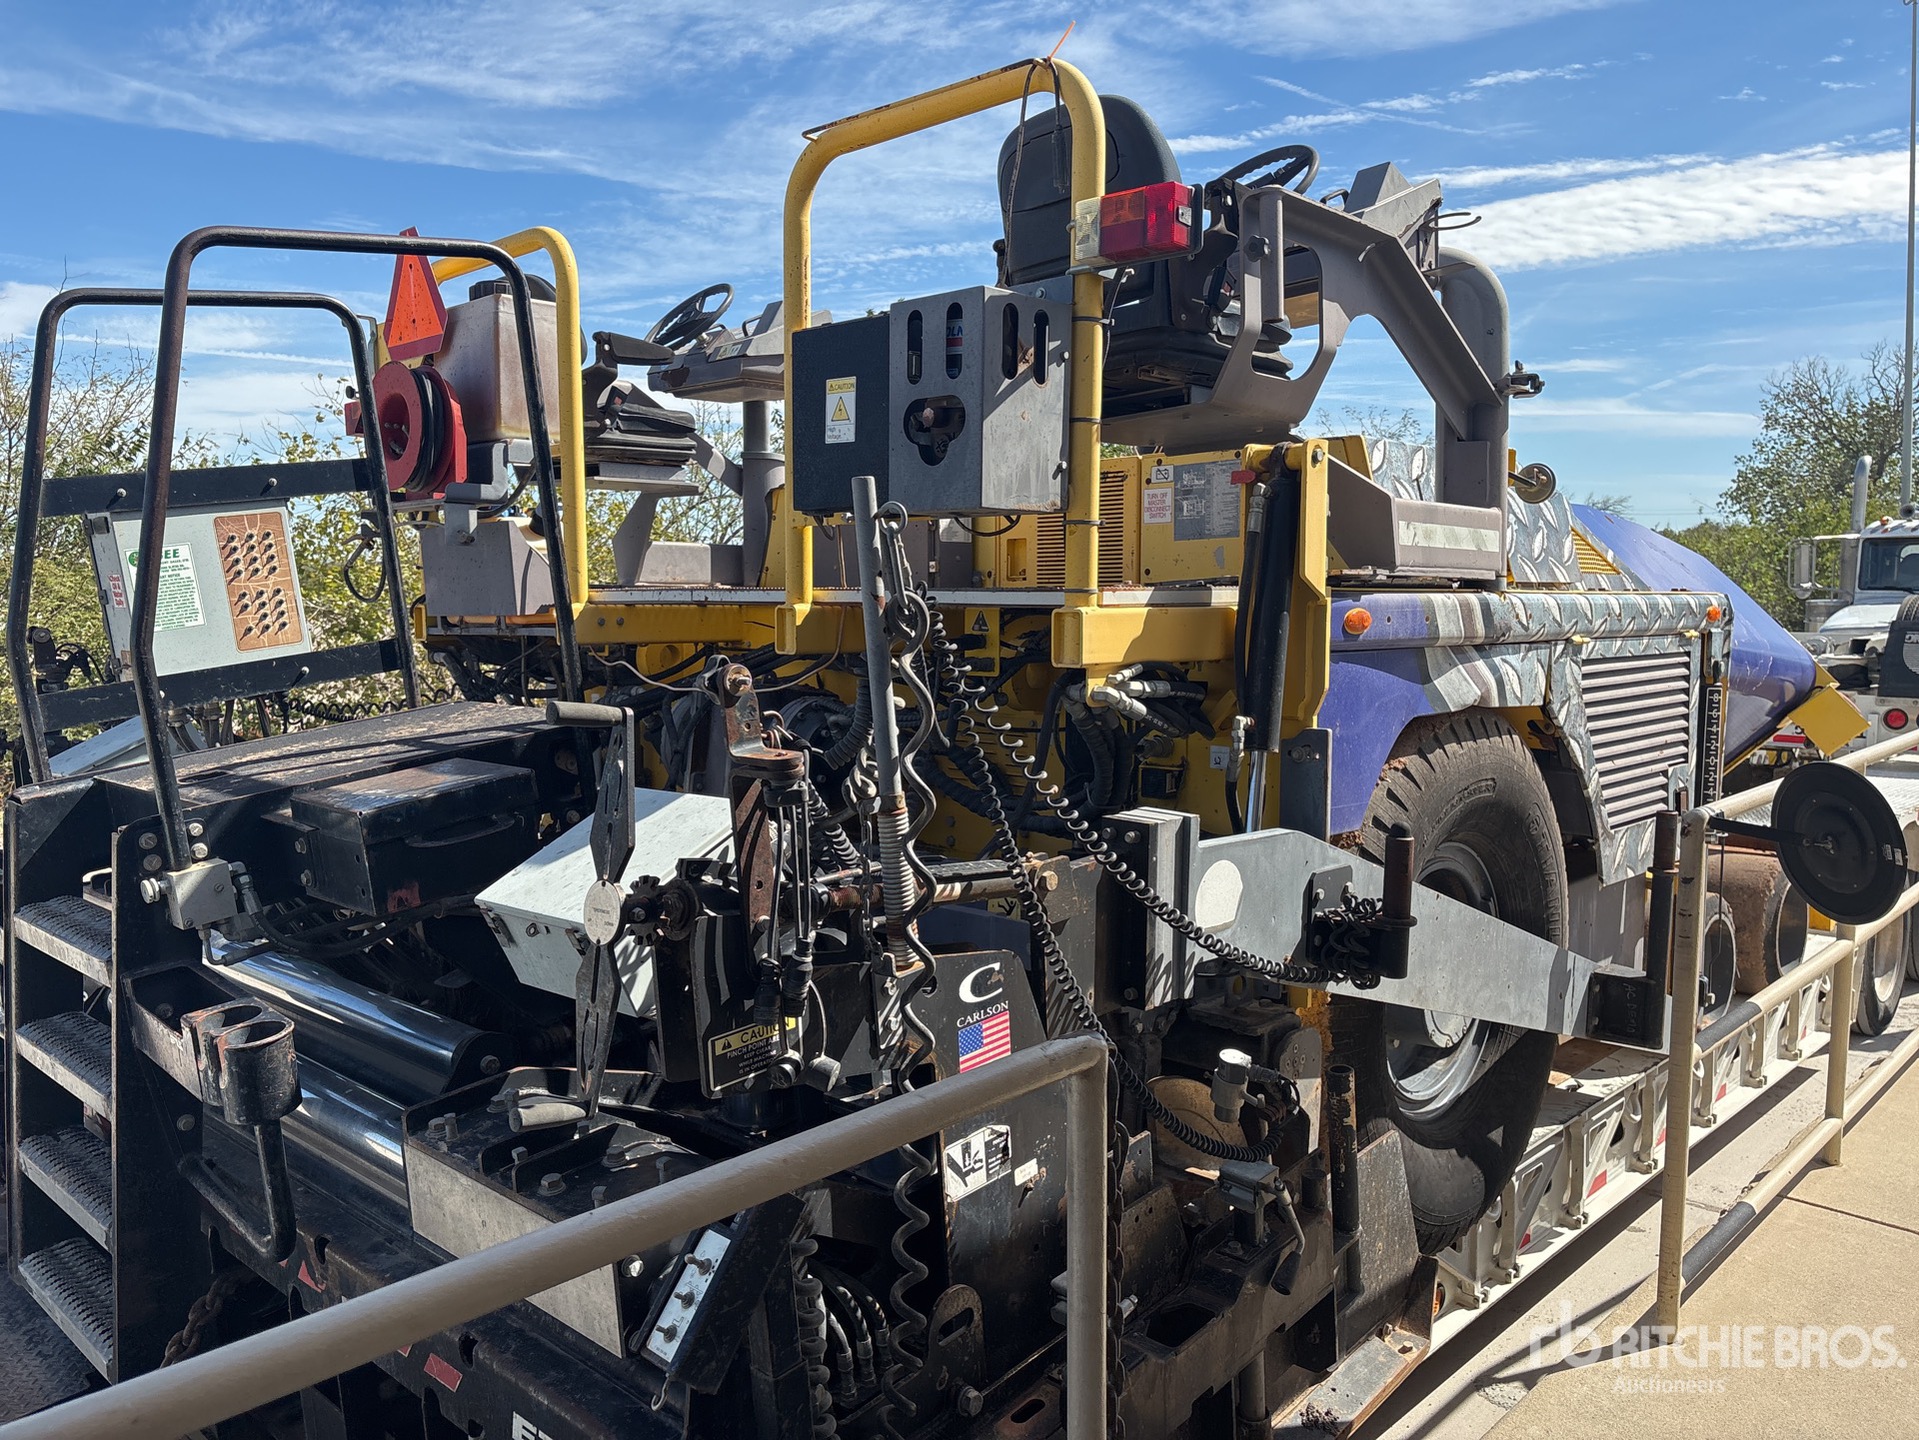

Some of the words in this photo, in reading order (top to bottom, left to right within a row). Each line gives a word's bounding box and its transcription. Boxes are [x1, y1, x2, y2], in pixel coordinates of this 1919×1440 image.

[1147, 492, 1159, 500] TURN
[1160, 491, 1168, 499] OFF
[1144, 505, 1171, 513] DISCONNECT
[1713, 692, 1719, 703] 8
[1712, 708, 1718, 718] 6
[1711, 724, 1717, 733] 4
[1710, 740, 1716, 750] 2
[1709, 756, 1715, 766] 0
[1708, 772, 1714, 781] 2
[1708, 787, 1714, 797] 4
[956, 1000, 1009, 1028] CARLSON
[727, 1045, 747, 1060] PINCH
[748, 1039, 767, 1053] POINT
[743, 1050, 756, 1059] KEEP
[756, 1046, 771, 1055] CLEAR
[738, 1058, 753, 1068] WHILE
[750, 1057, 776, 1071] OPERATIO
